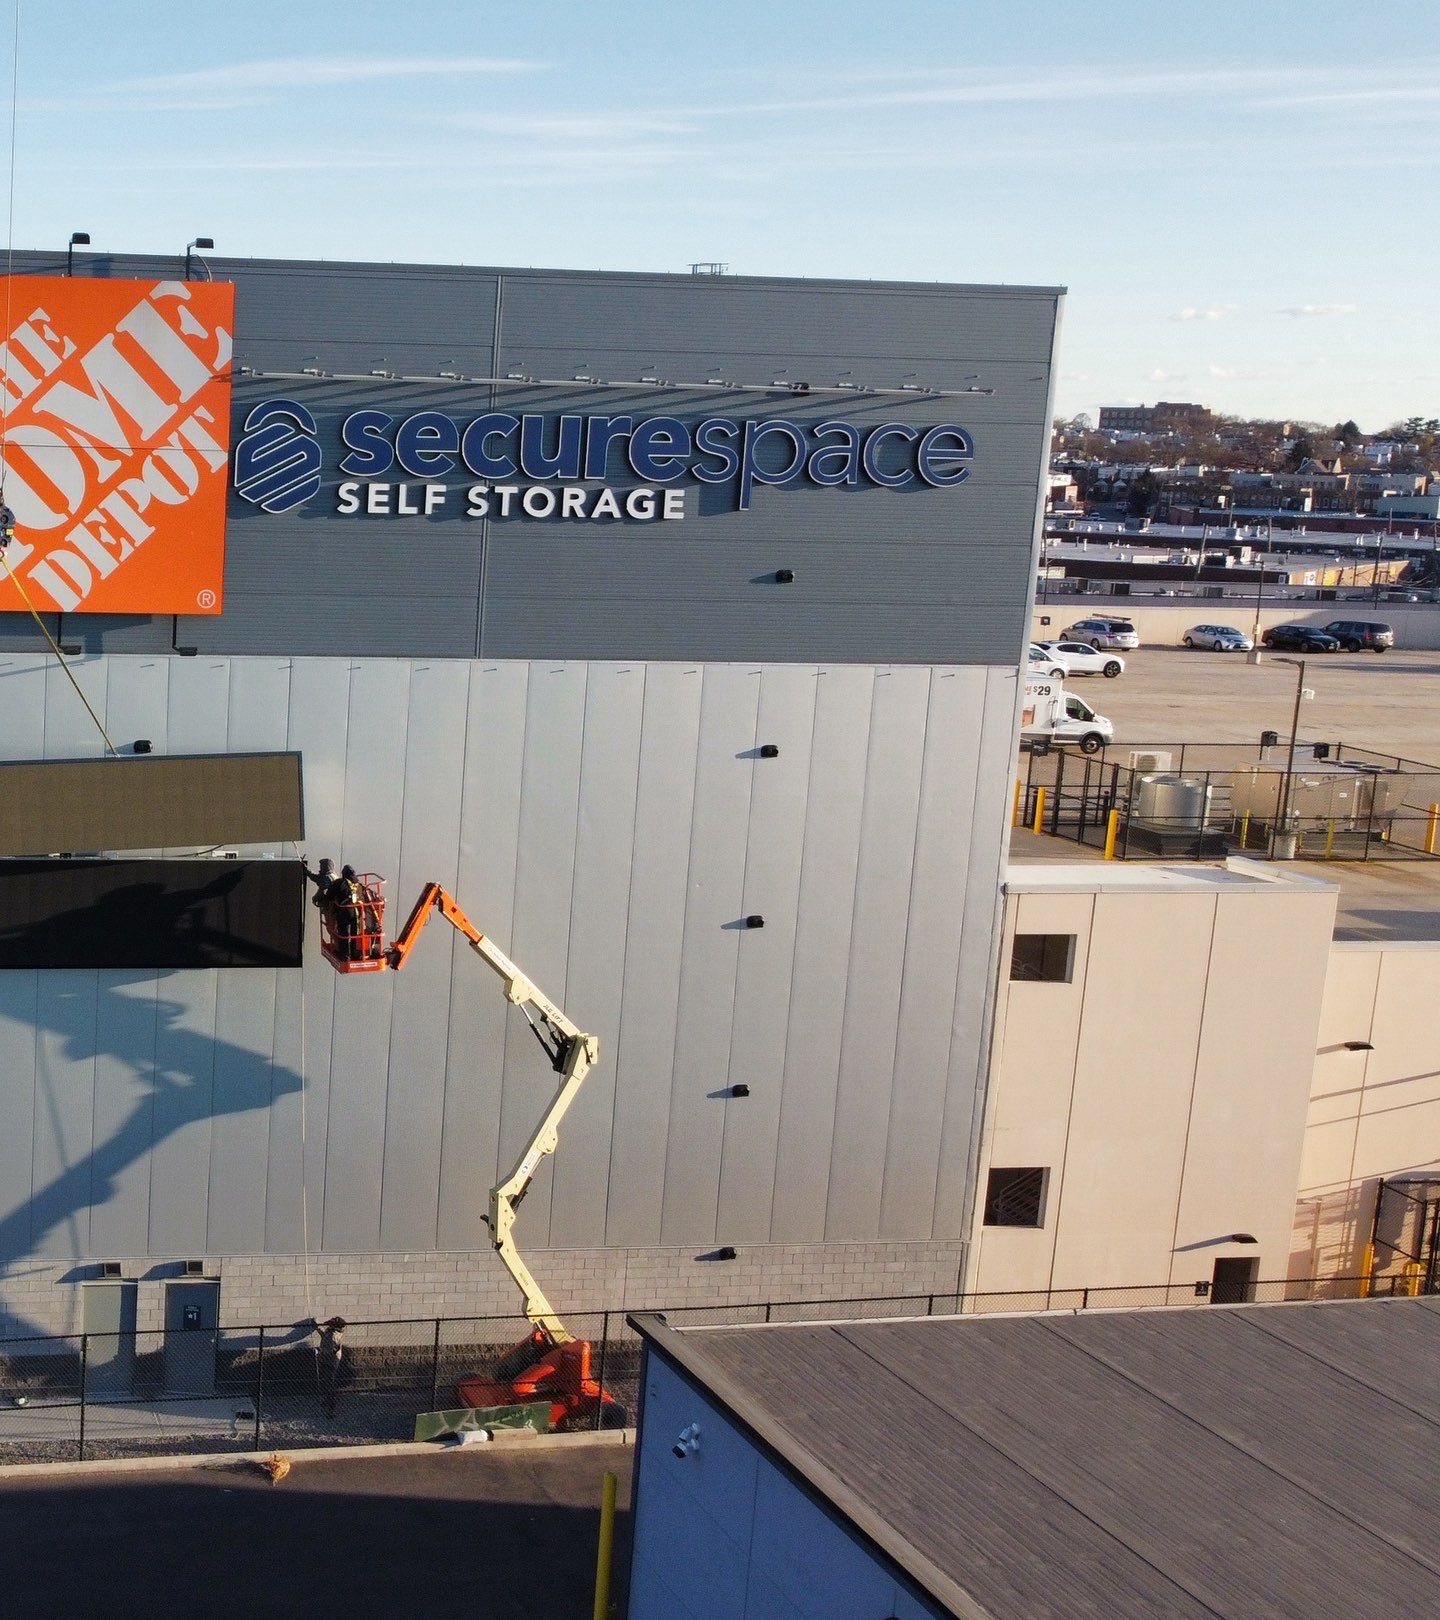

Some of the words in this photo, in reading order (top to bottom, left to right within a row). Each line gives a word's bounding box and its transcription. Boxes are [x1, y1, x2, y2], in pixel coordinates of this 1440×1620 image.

[339, 410, 975, 511] securespace
[27, 405, 228, 612] DEPOT
[336, 482, 447, 516] SELF
[467, 485, 685, 520] STORAGE
[1033, 685, 1051, 696] $29
